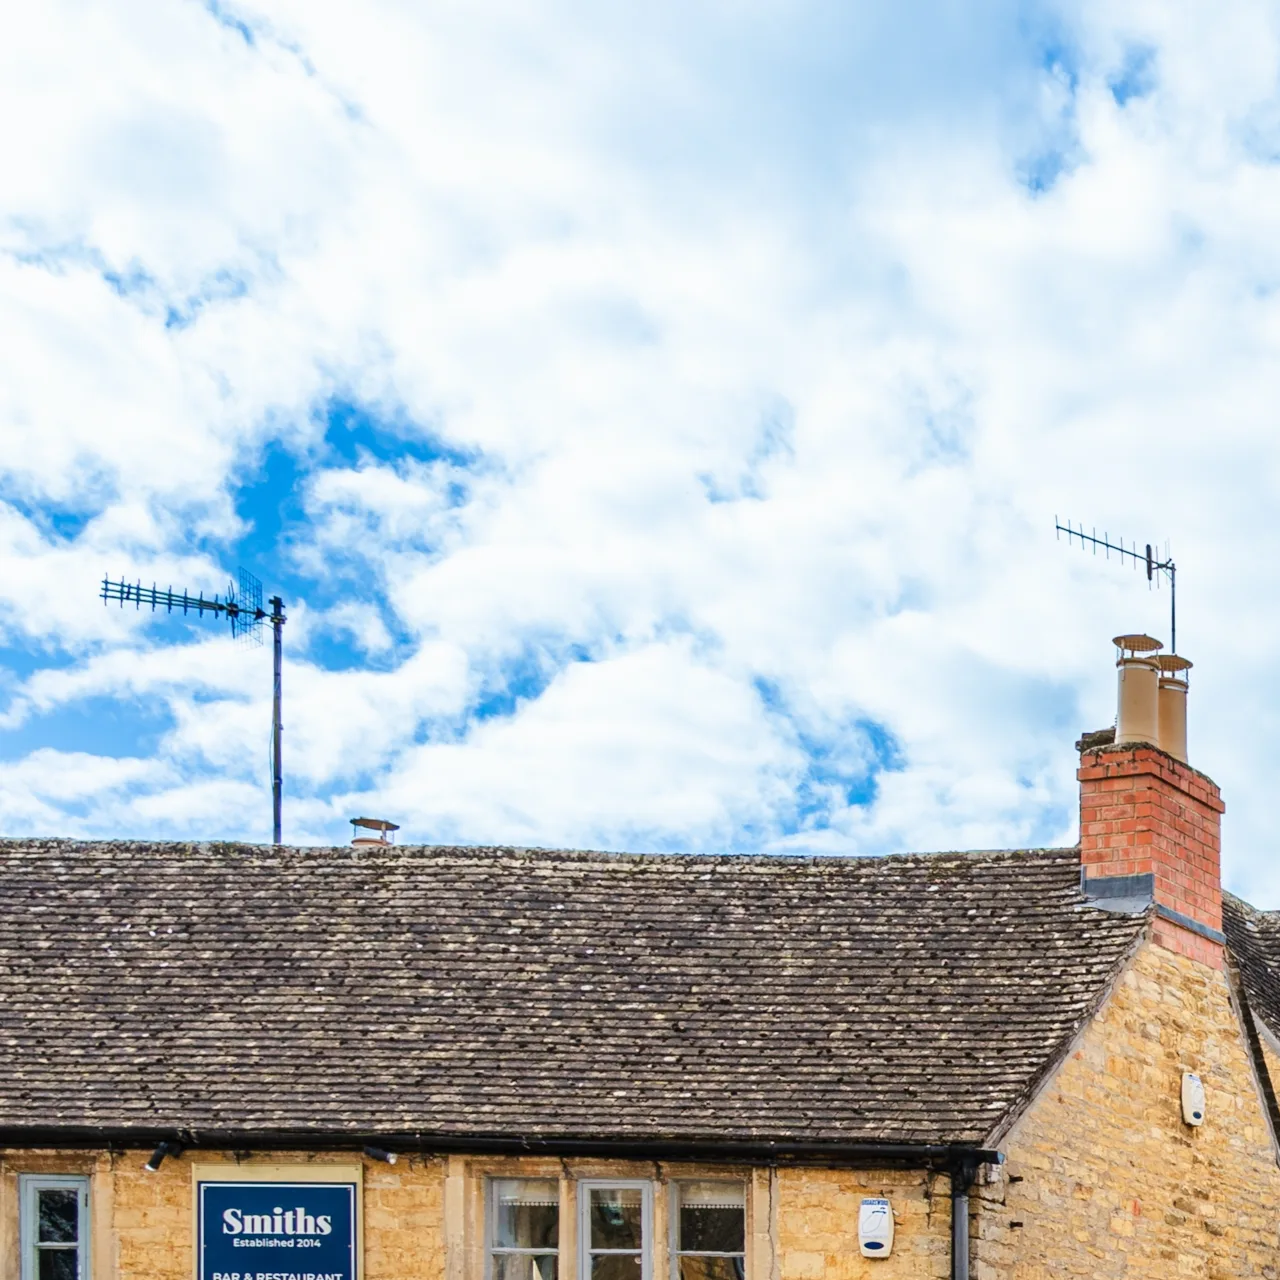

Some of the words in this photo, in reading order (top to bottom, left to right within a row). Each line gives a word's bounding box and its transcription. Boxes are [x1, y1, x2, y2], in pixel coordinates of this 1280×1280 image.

[222, 1207, 332, 1236] Smiths
[233, 1238, 294, 1248] Established
[296, 1238, 321, 1248] 2014
